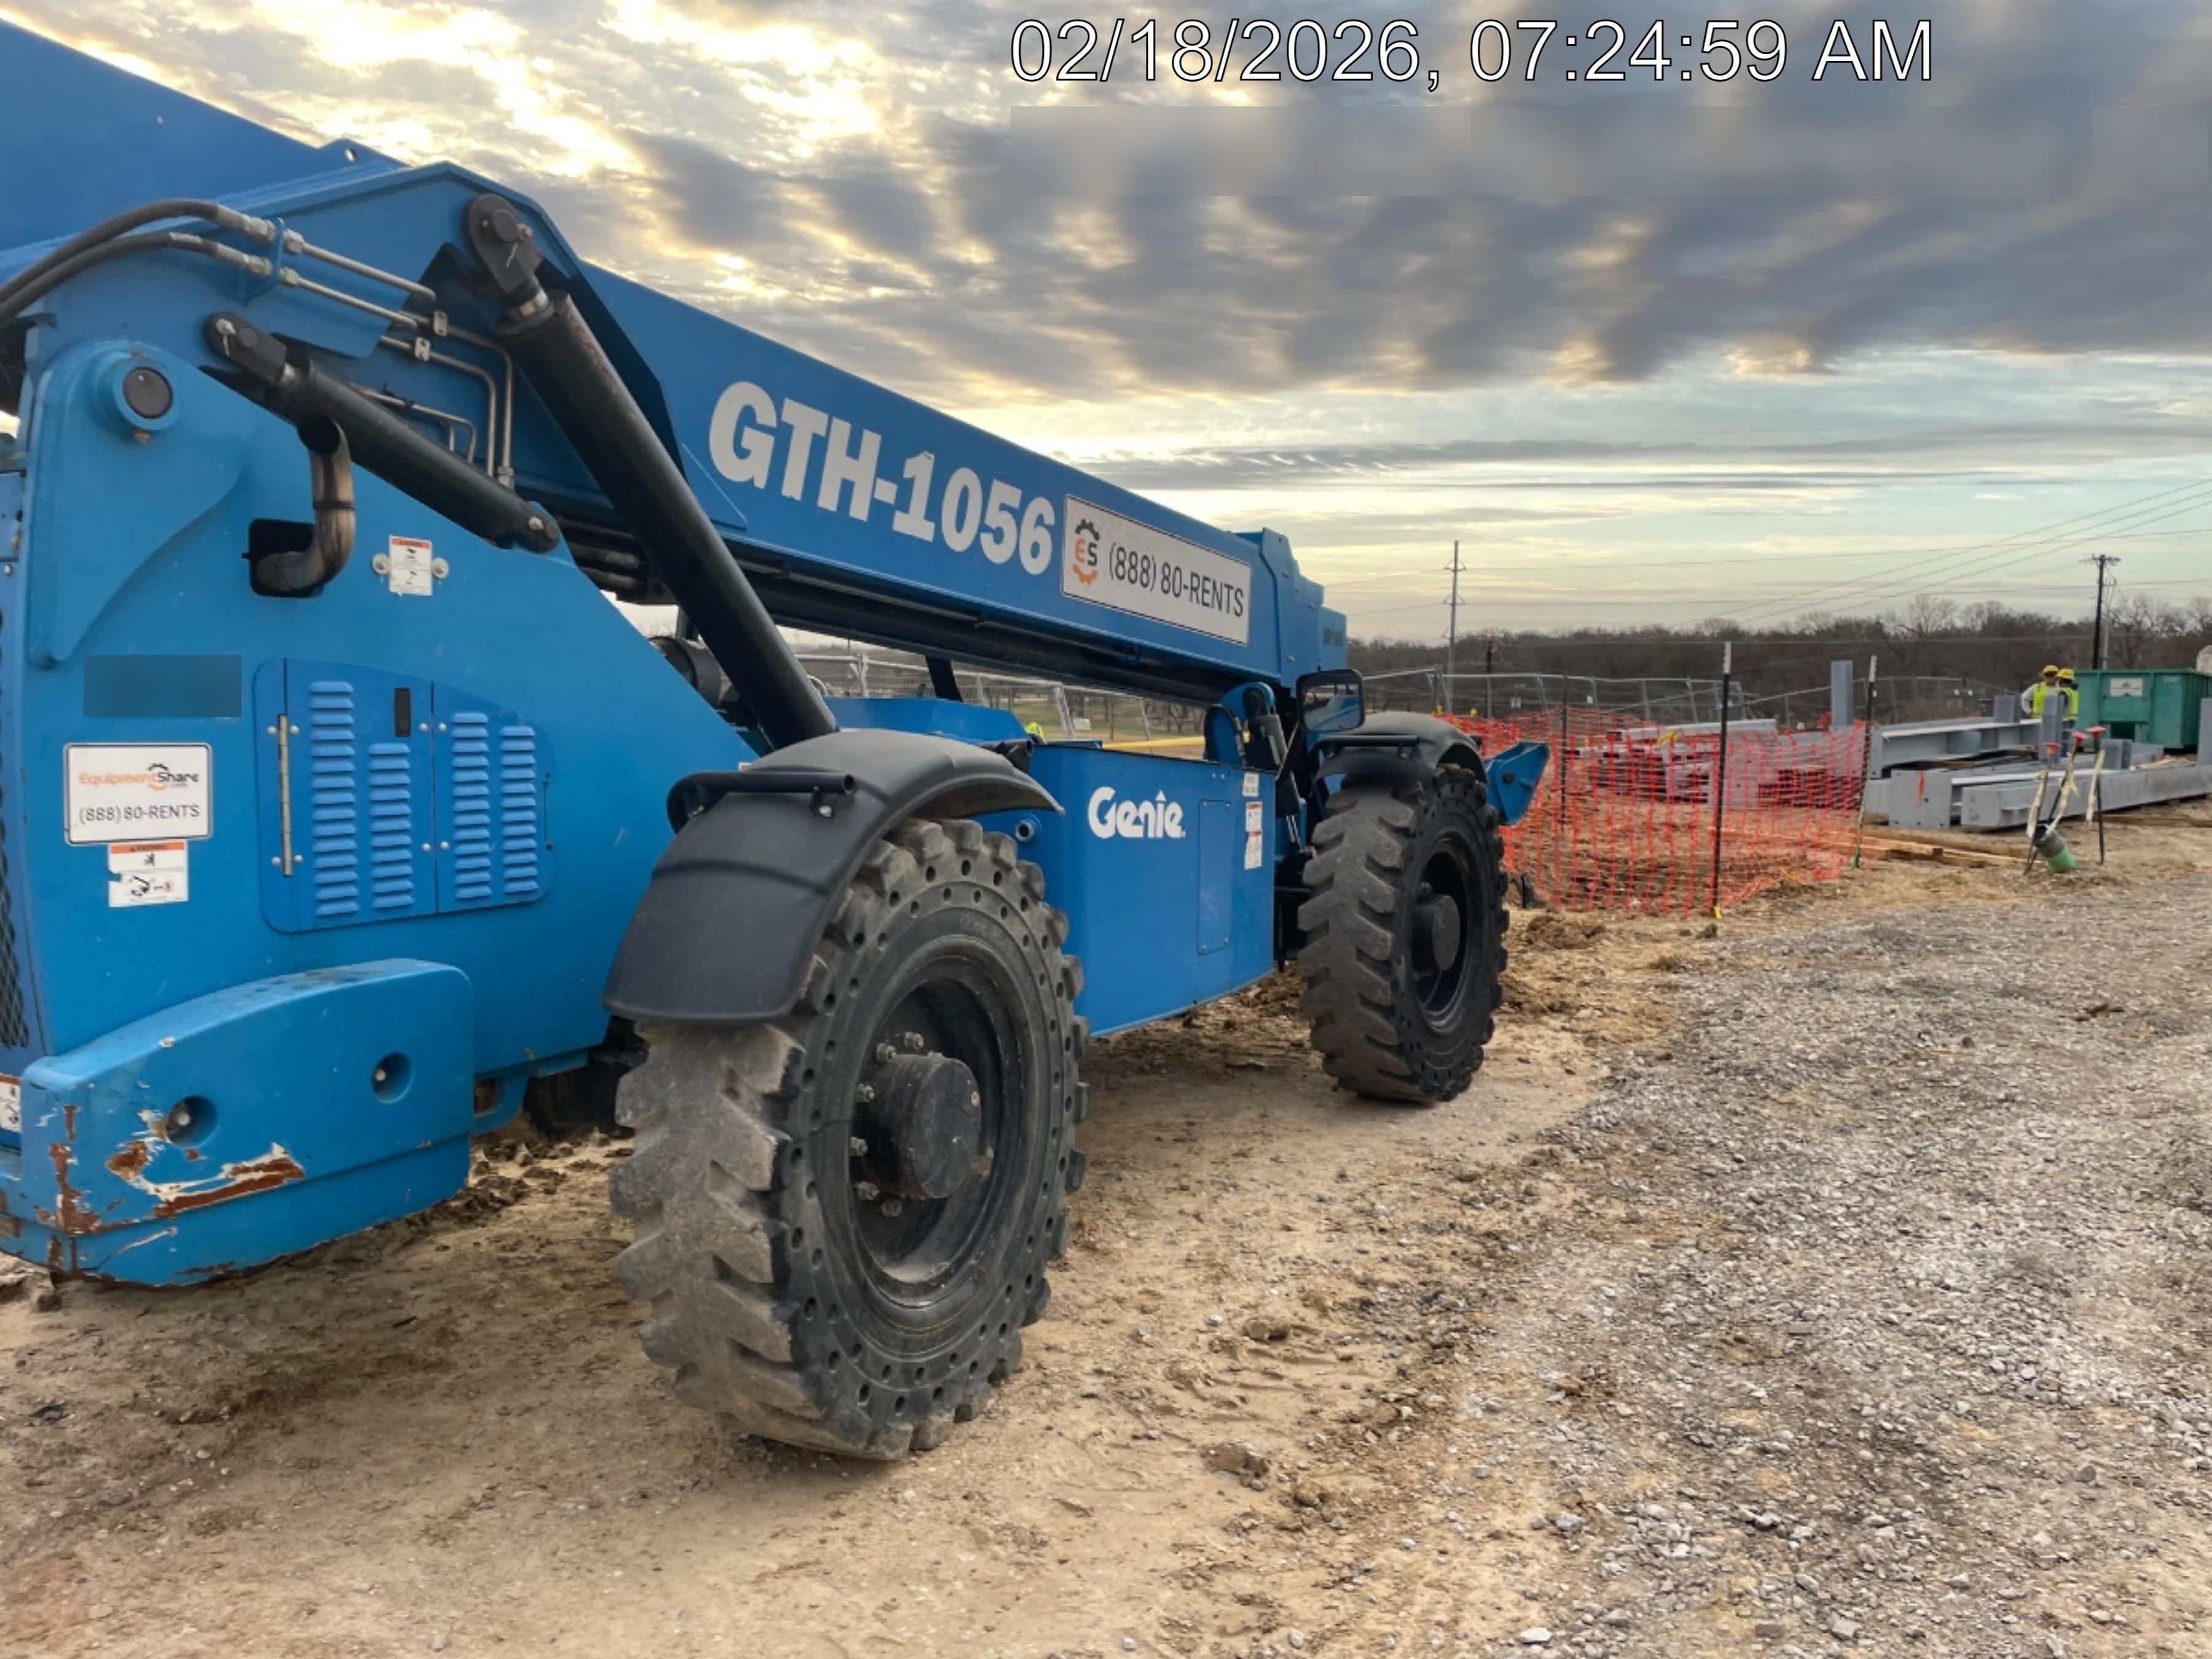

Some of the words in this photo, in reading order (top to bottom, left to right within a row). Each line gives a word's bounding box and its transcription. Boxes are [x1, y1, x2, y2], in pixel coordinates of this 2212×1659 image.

[709, 381, 1056, 576] GTH-1056
[1109, 542, 1156, 592] (888)
[1161, 562, 1244, 618] 80-RENTS
[79, 806, 121, 825] (888)
[124, 804, 200, 821] 80-RENTS
[1088, 786, 1183, 839] Genie
